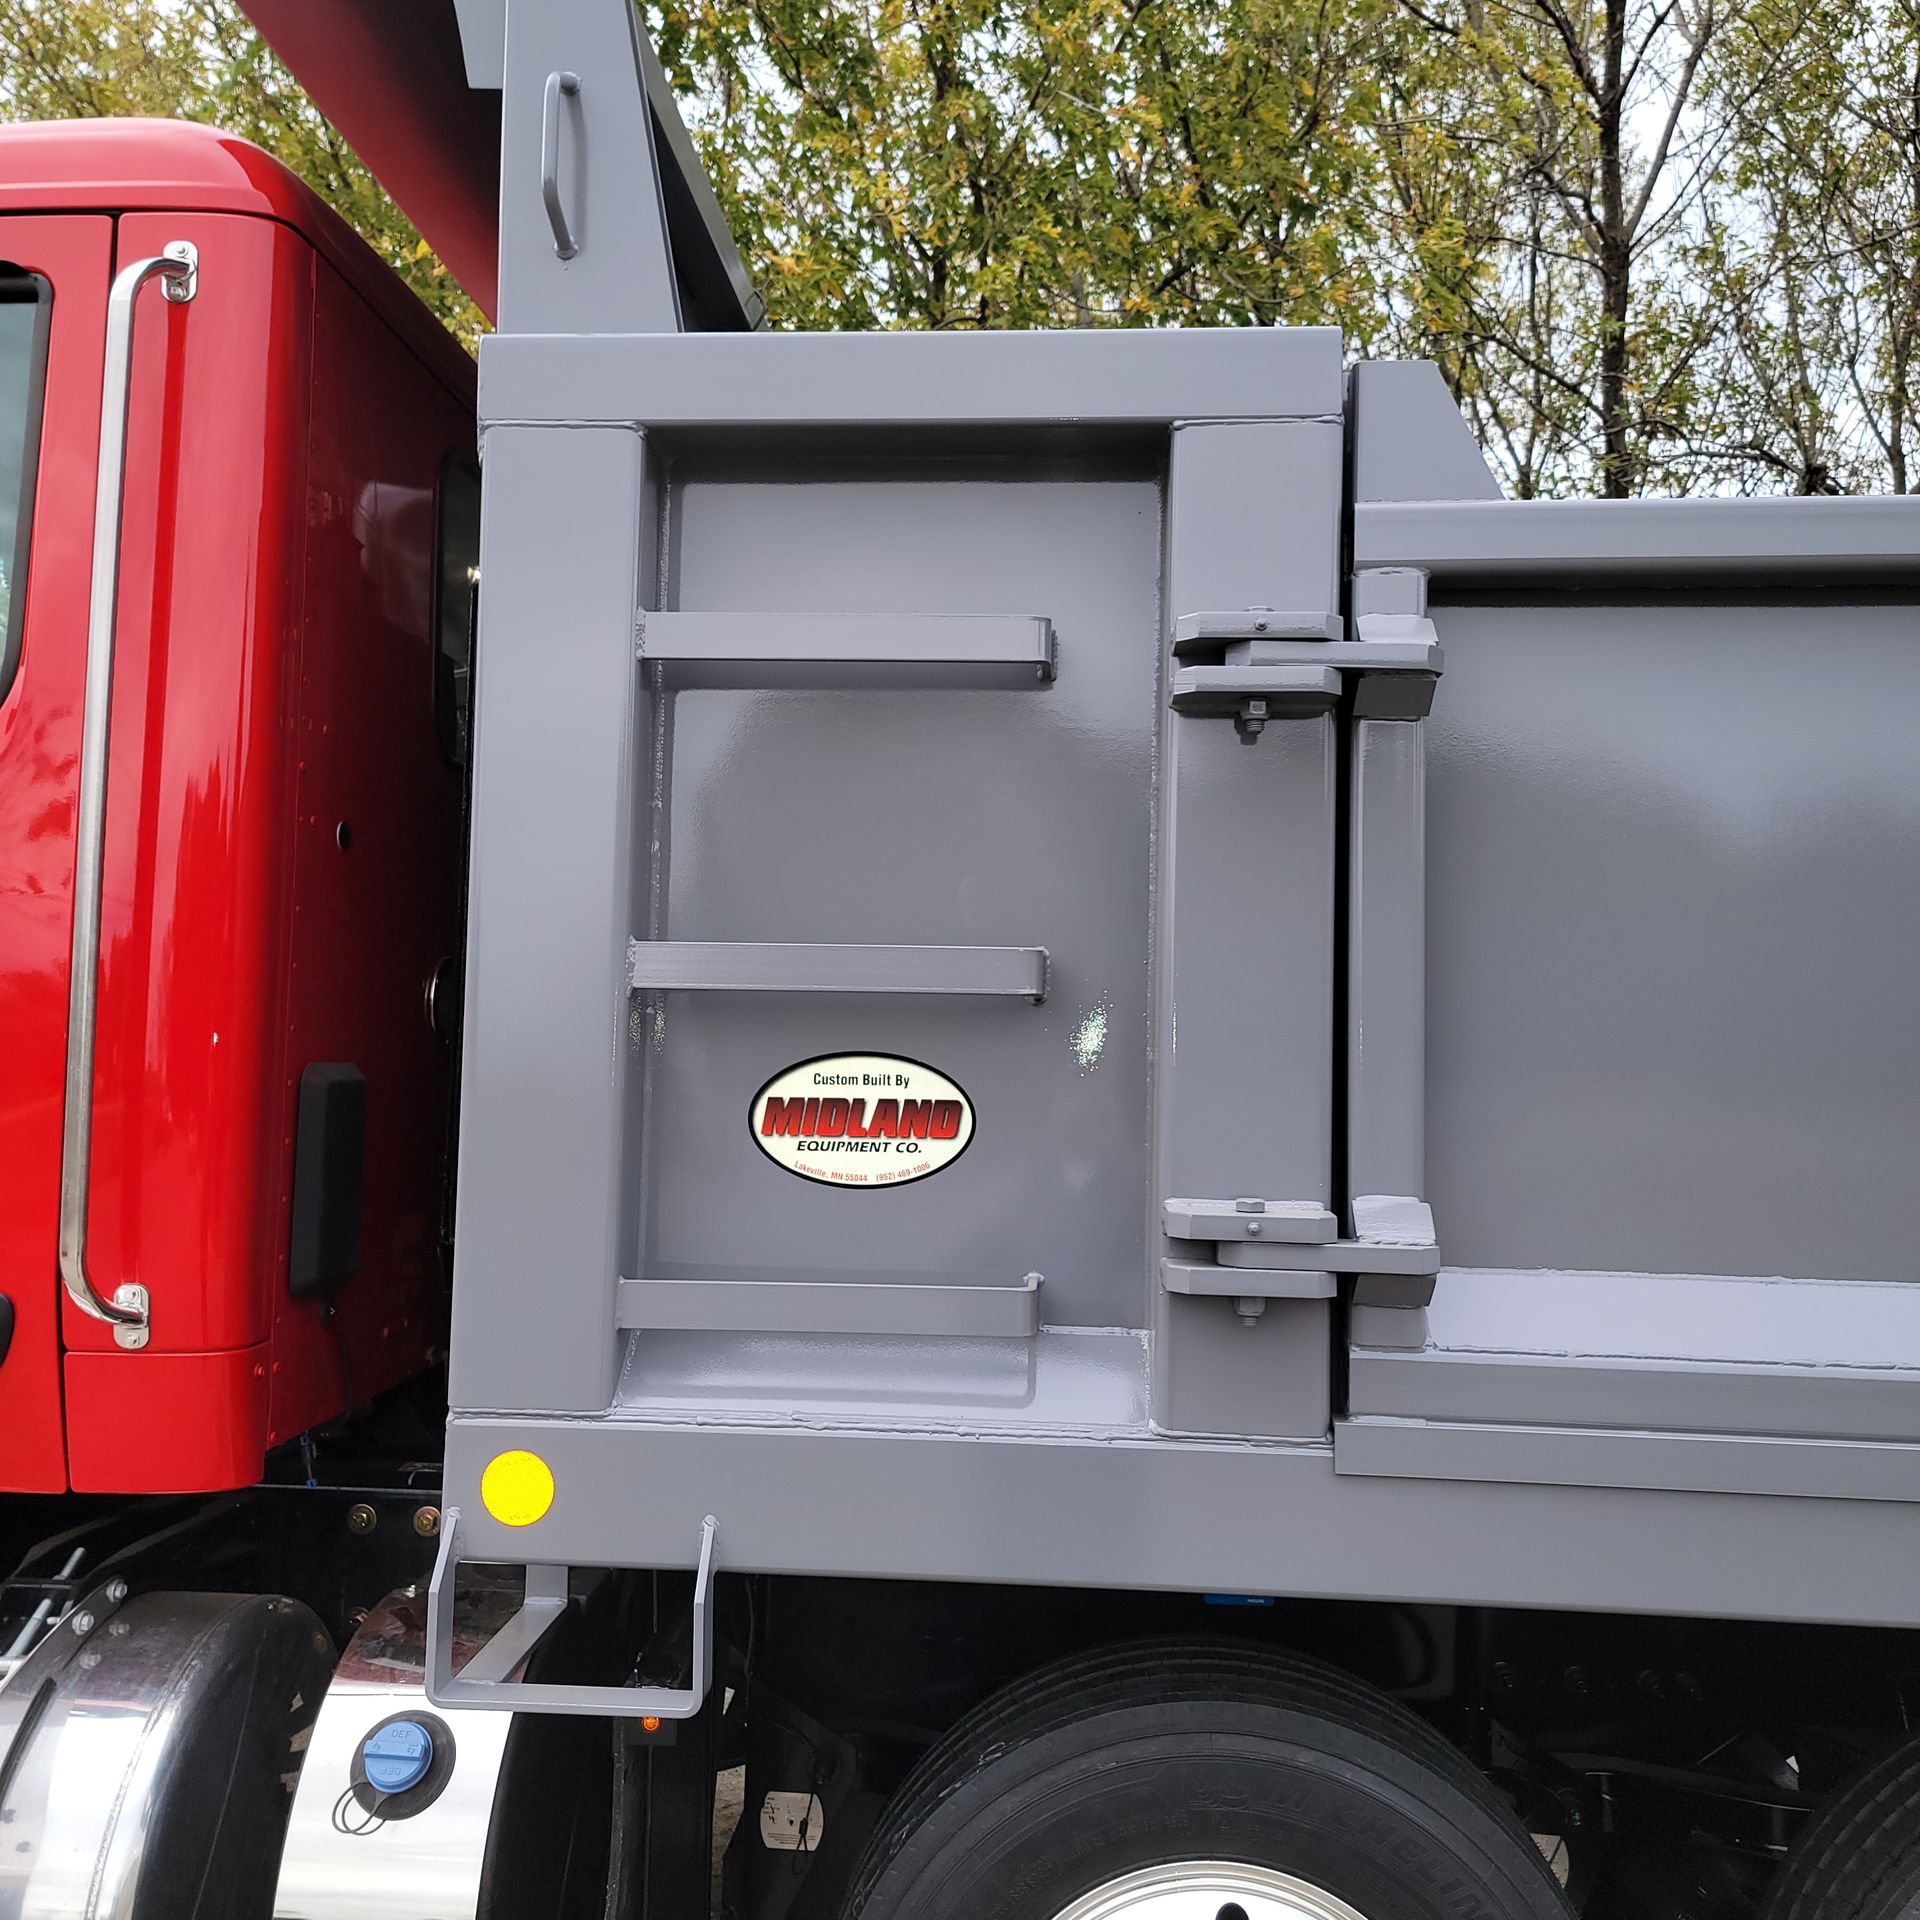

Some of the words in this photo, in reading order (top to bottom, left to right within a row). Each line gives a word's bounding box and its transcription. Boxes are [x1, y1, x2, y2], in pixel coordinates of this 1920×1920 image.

[813, 1072, 859, 1086] Custom
[863, 1073, 891, 1086] Built
[895, 1074, 910, 1089] By
[760, 1096, 964, 1140] MIDLAND
[796, 1140, 892, 1153] EQUIPMENT
[895, 1142, 923, 1154] CO.
[794, 1160, 828, 1179] Lakeville,
[830, 1171, 843, 1180] MN
[845, 1173, 868, 1182] 55044
[876, 1171, 896, 1182] (952)
[897, 1161, 931, 1178] 469-1006
[391, 1729, 412, 1739] DEF
